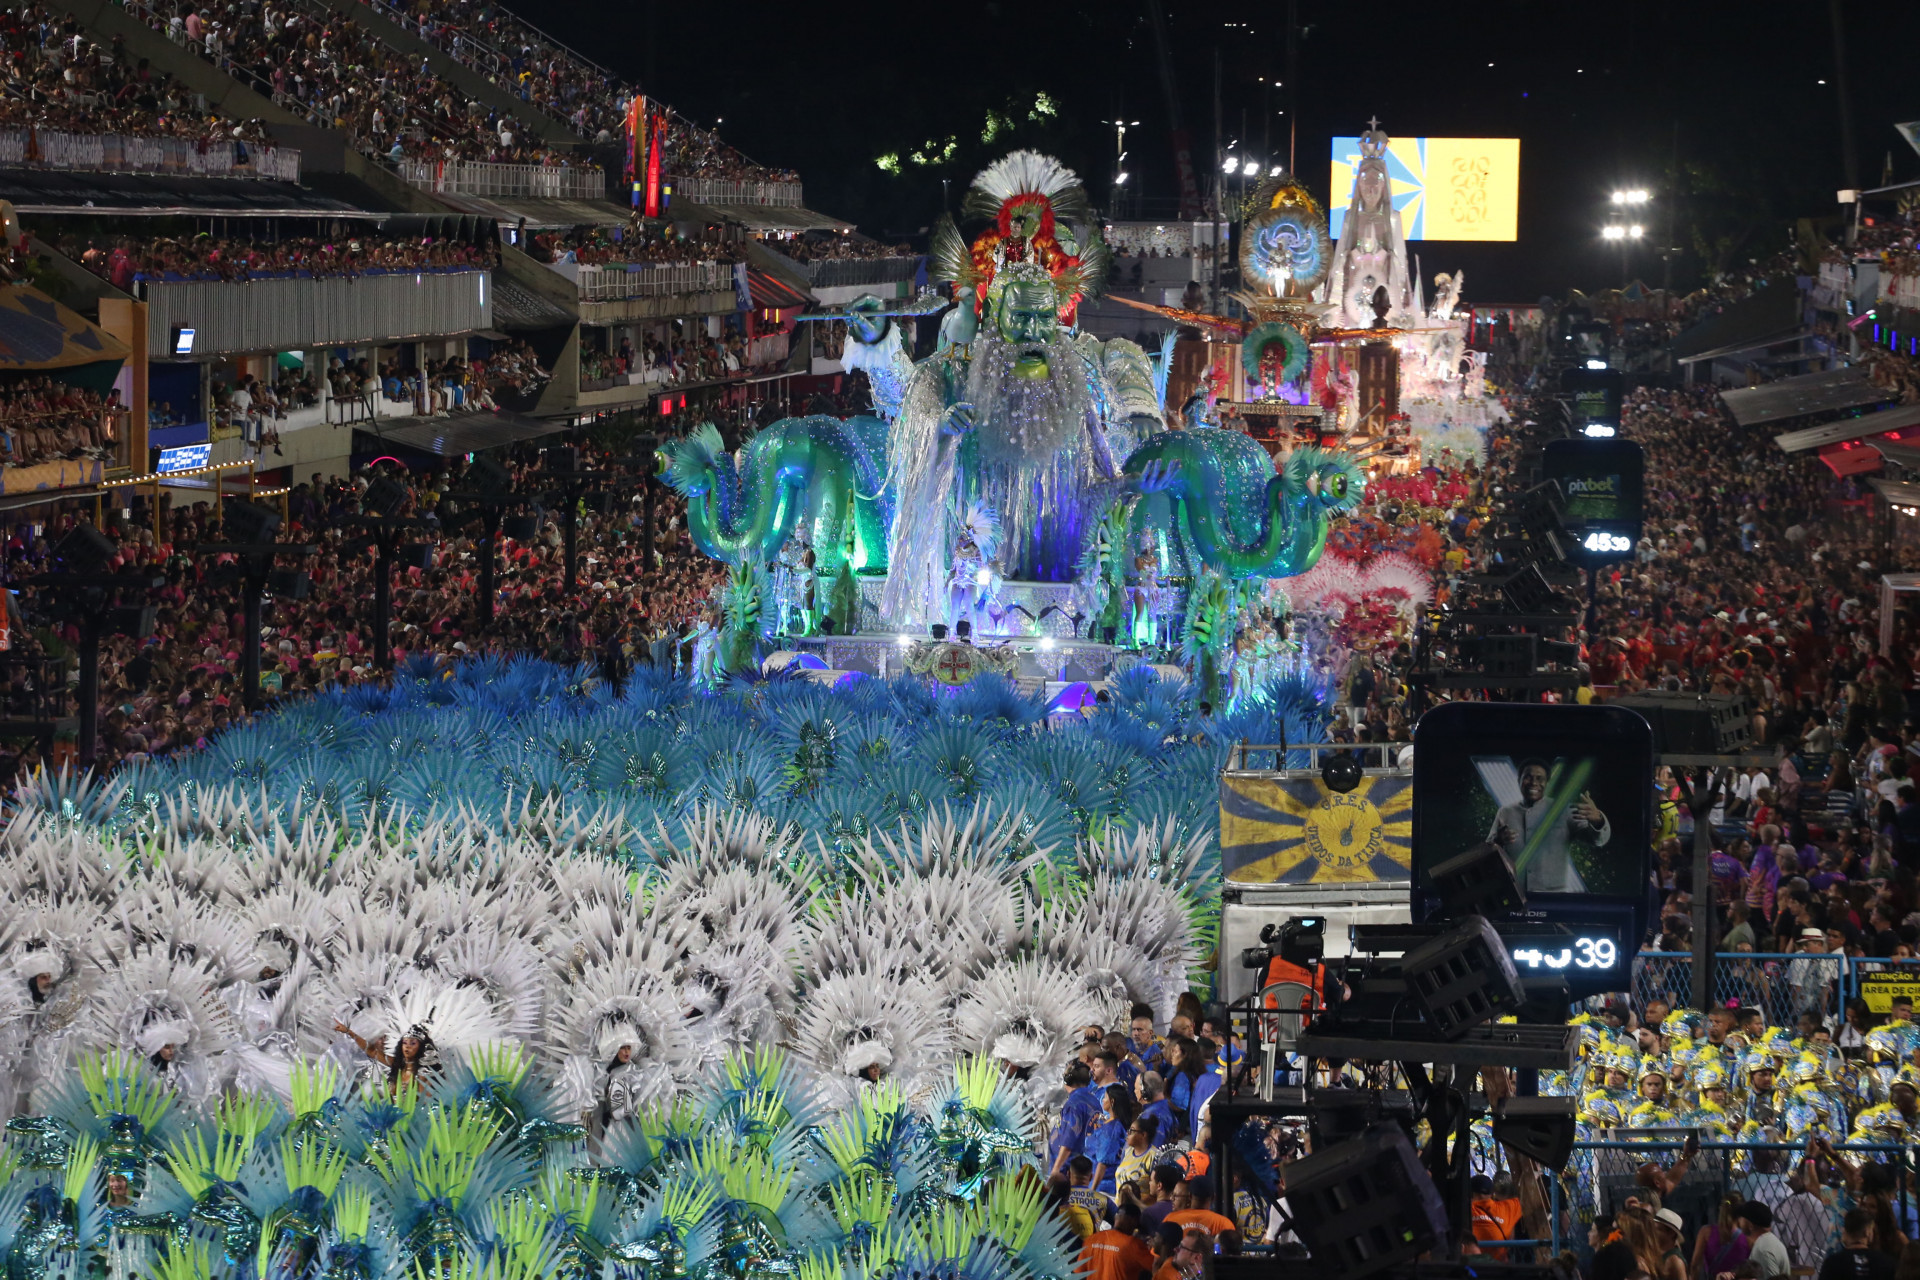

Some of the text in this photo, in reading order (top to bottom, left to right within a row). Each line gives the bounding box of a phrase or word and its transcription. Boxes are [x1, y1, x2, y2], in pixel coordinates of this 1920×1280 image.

[1568, 476, 1614, 494] pixbet
[1307, 825, 1382, 866] UNIDOS DA TIJUCA
[1865, 985, 1889, 993] ÁREA
[1069, 1196, 1100, 1207] STAQUE
